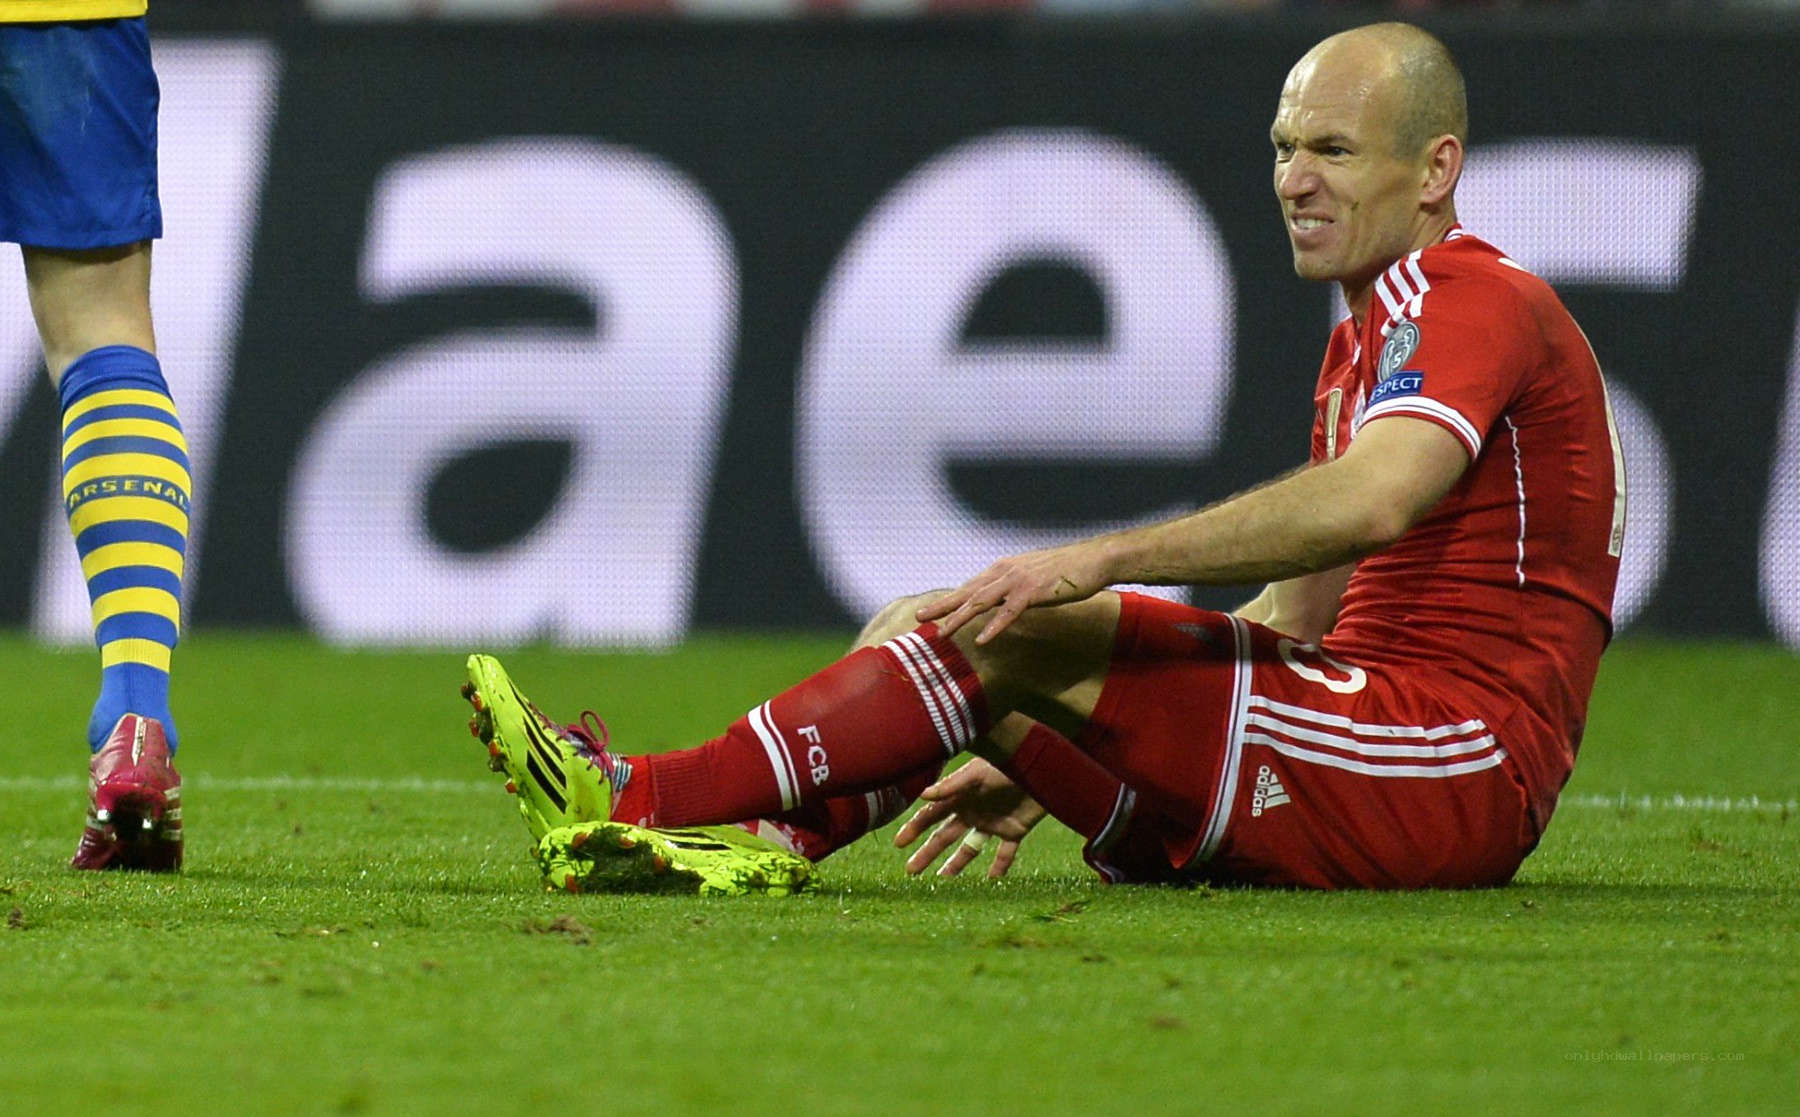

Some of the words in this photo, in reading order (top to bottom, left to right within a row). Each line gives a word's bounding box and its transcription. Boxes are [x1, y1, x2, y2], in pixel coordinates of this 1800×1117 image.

[69, 479, 188, 510] ARSENAL
[796, 724, 830, 786] FCB
[1251, 765, 1271, 818] adidas
